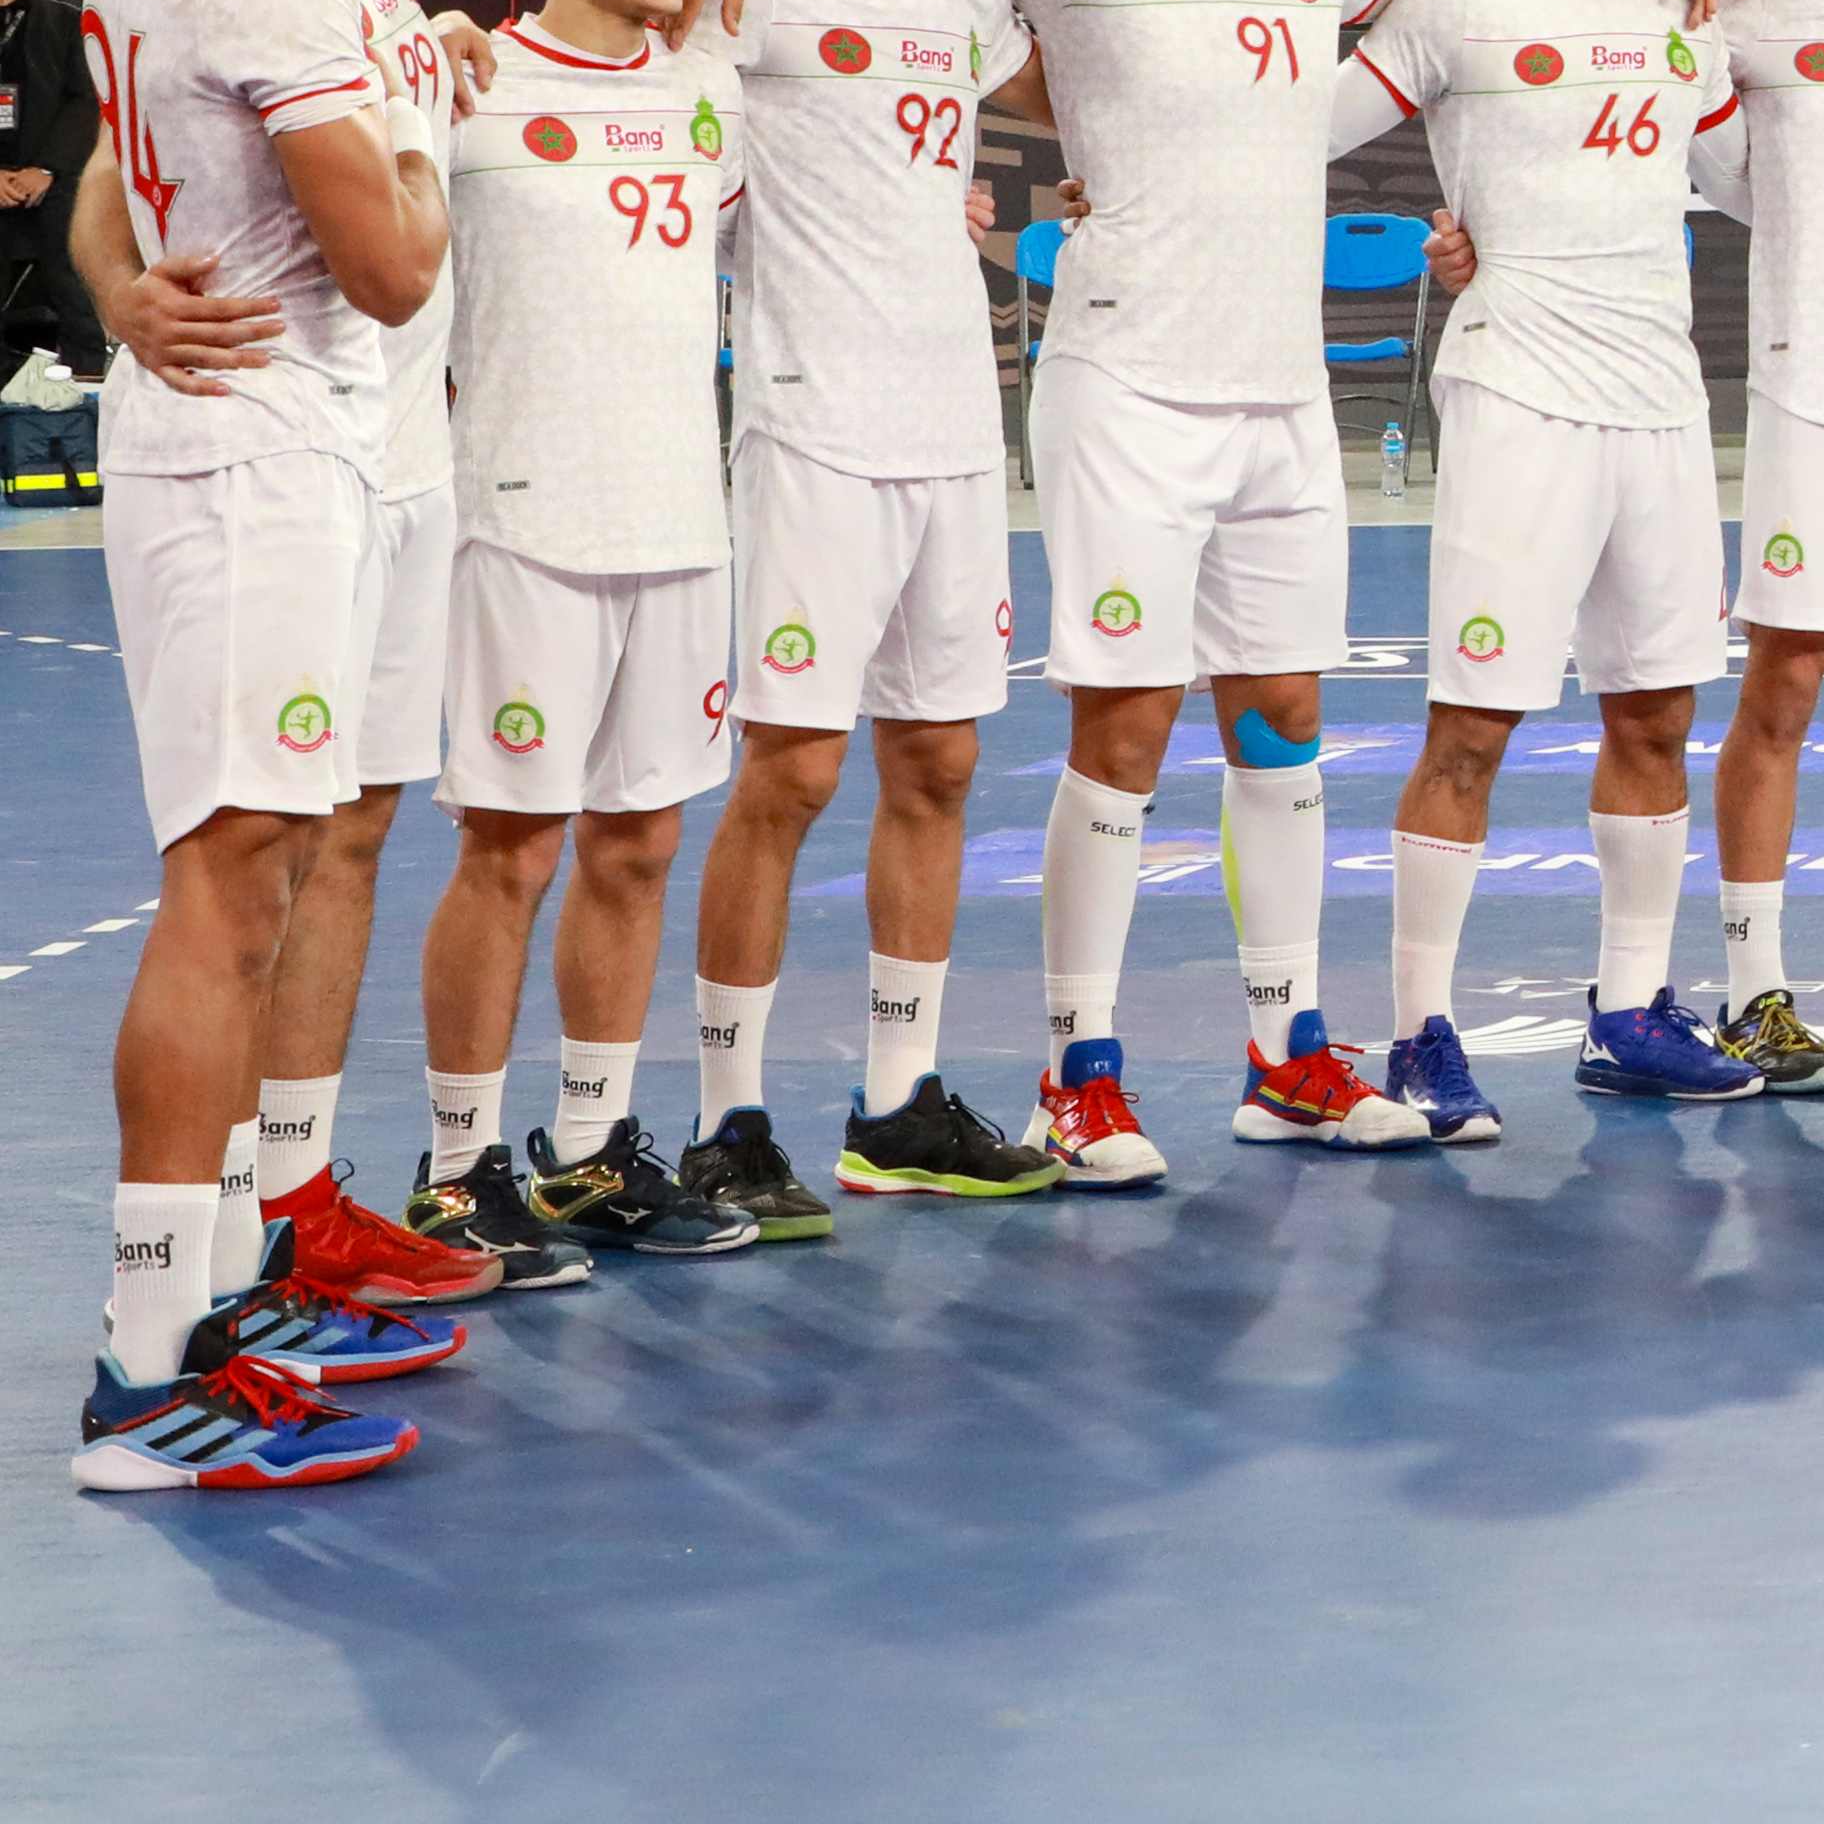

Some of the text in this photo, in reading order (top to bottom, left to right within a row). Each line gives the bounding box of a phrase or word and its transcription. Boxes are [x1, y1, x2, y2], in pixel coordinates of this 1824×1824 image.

[397, 32, 439, 110] 99
[900, 39, 952, 72] Bang
[1235, 15, 1301, 82] 91
[1591, 45, 1643, 69] Bang
[604, 123, 661, 151] Bang
[895, 91, 964, 170] 92
[1581, 93, 1661, 158] 46
[607, 172, 694, 250] 93
